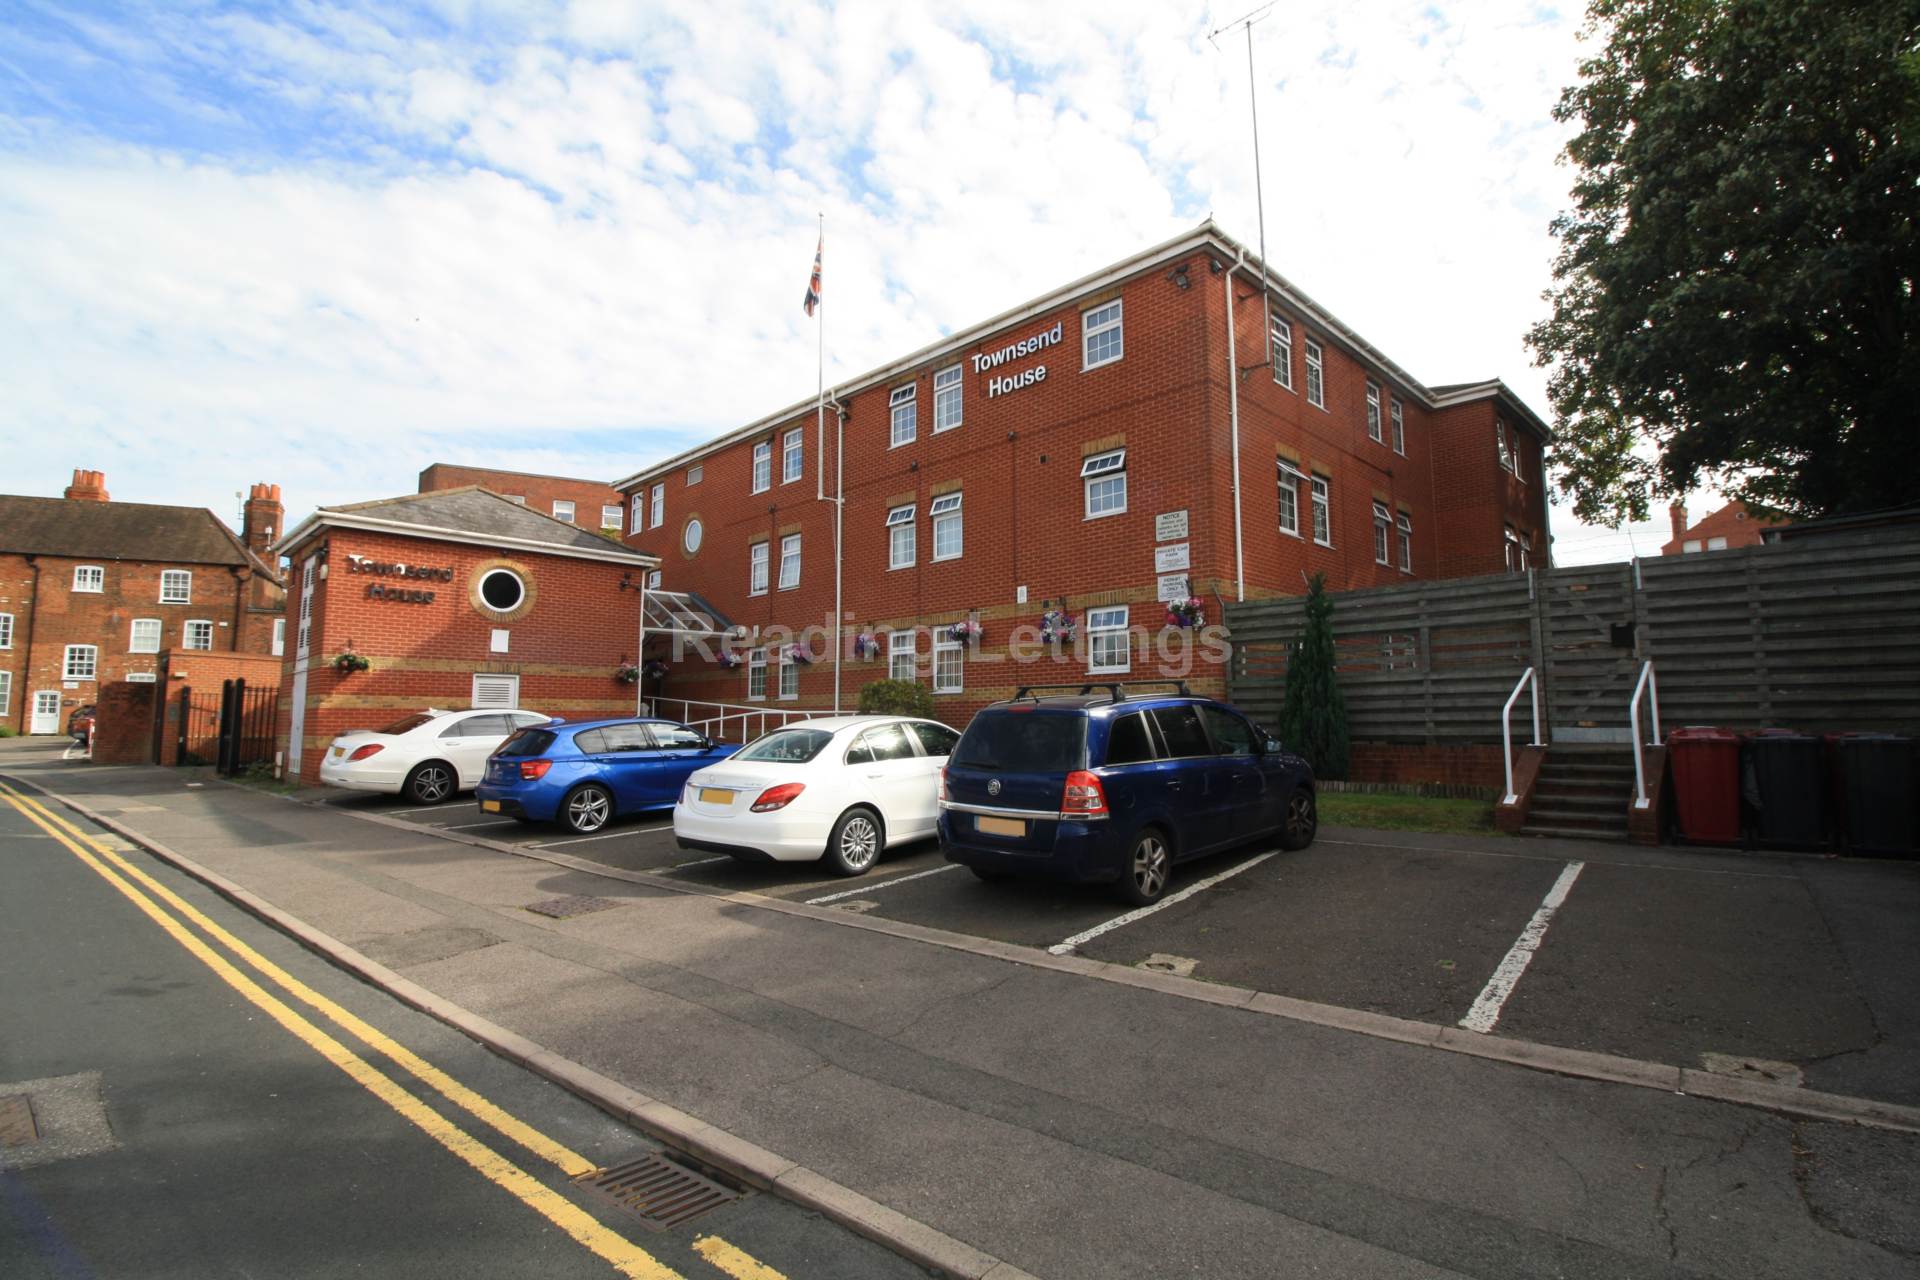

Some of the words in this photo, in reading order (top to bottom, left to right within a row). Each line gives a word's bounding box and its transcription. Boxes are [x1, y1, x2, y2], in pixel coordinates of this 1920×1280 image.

[971, 321, 1062, 374] Townsend
[989, 365, 1046, 398] House
[347, 553, 453, 582] Townsend
[366, 582, 435, 605] House
